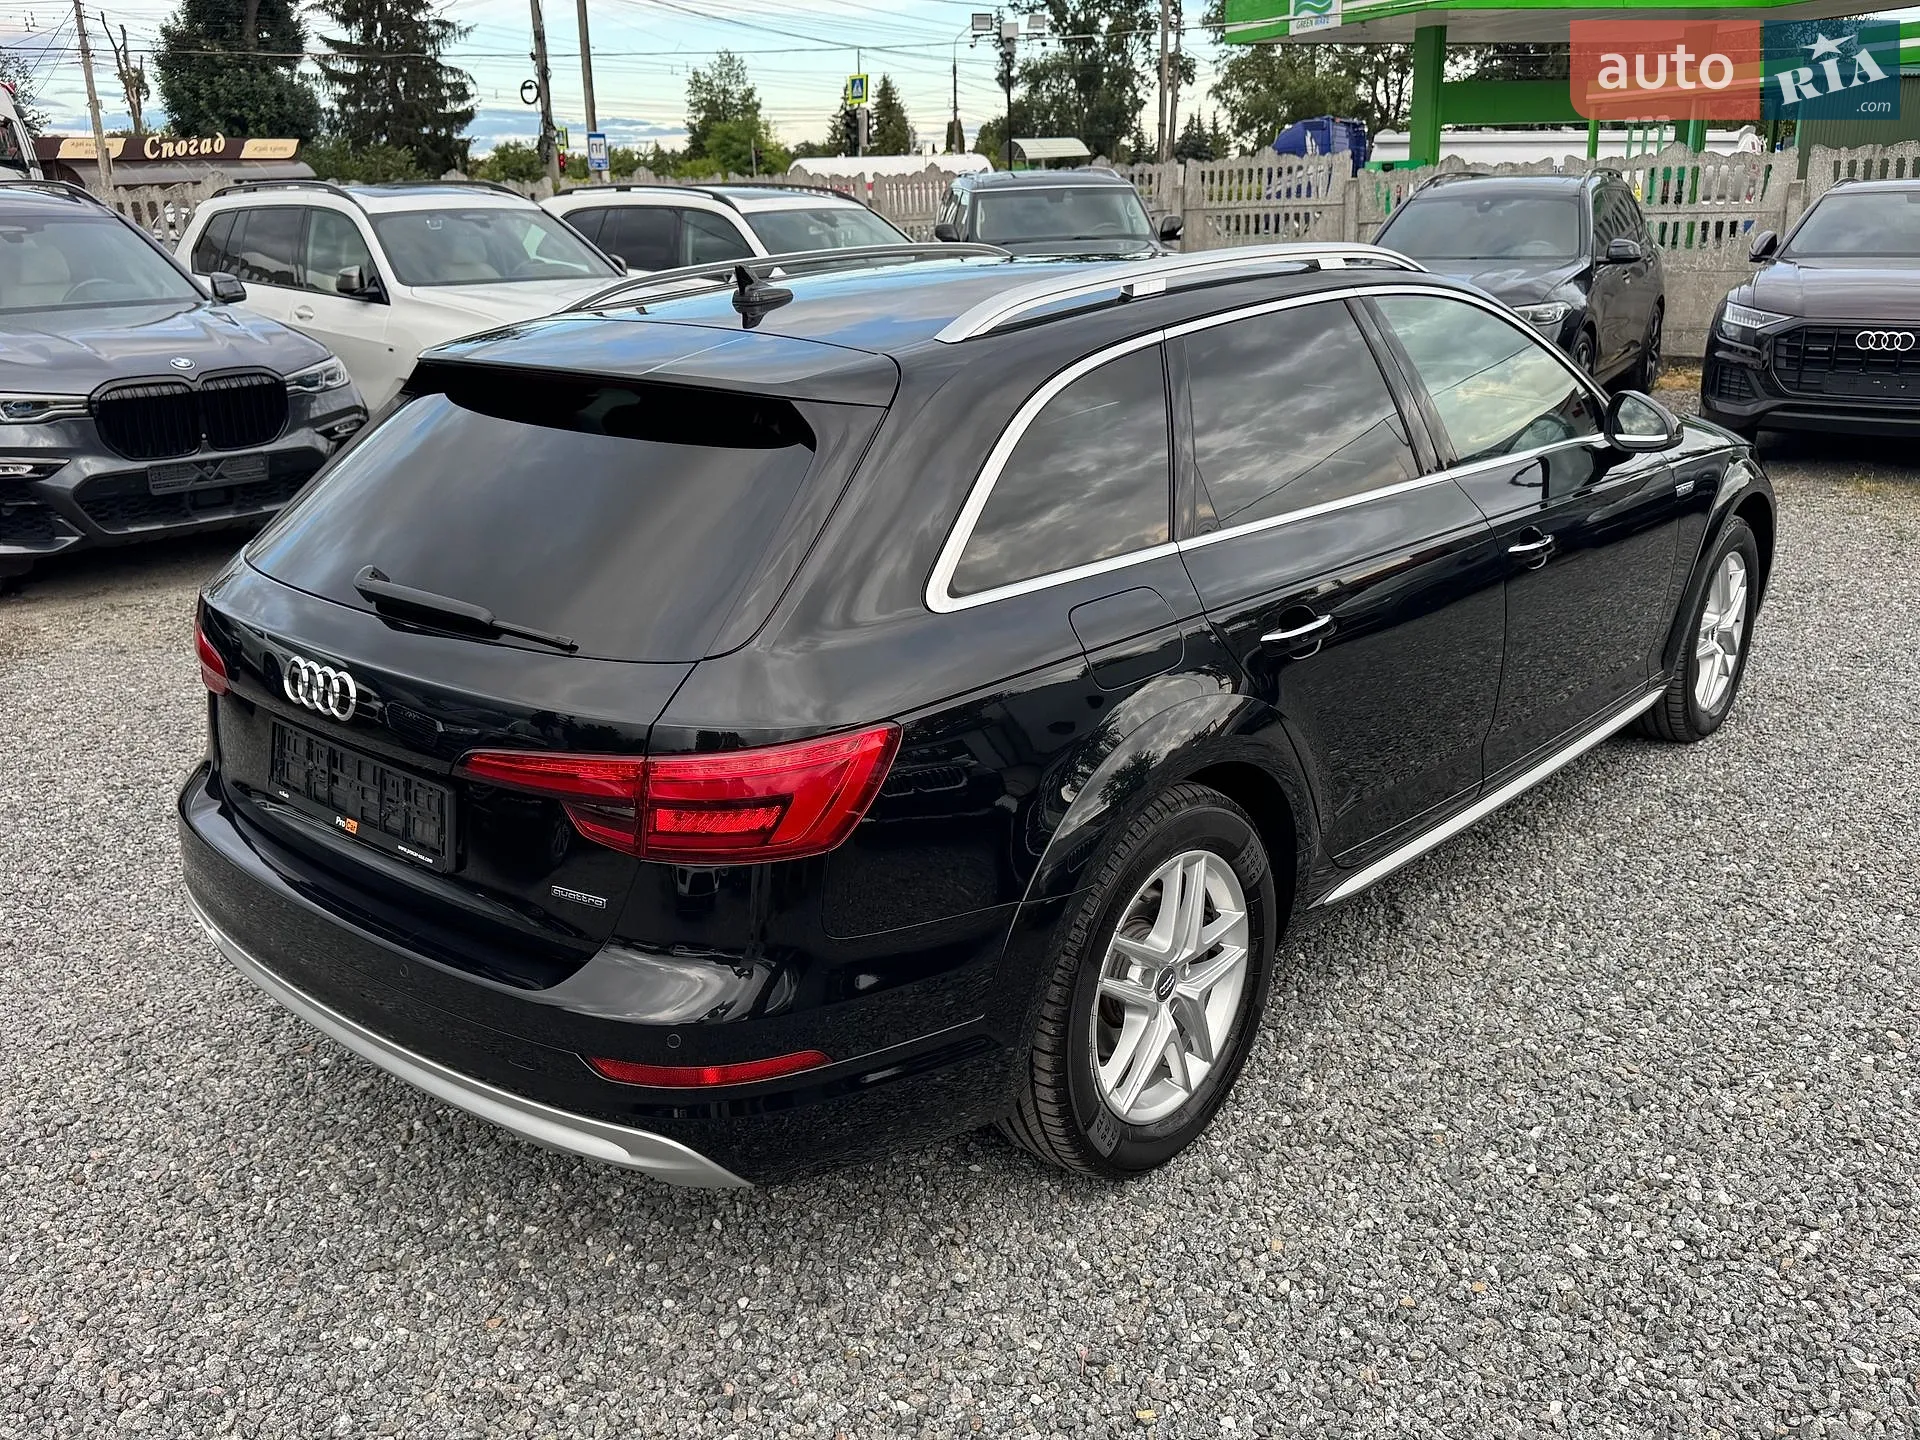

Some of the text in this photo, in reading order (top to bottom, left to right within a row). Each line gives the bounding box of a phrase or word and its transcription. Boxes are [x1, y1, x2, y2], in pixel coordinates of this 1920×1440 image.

[1296, 18, 1313, 29] GREEN
[143, 132, 226, 160] Спогад
[552, 888, 603, 907] quattro
